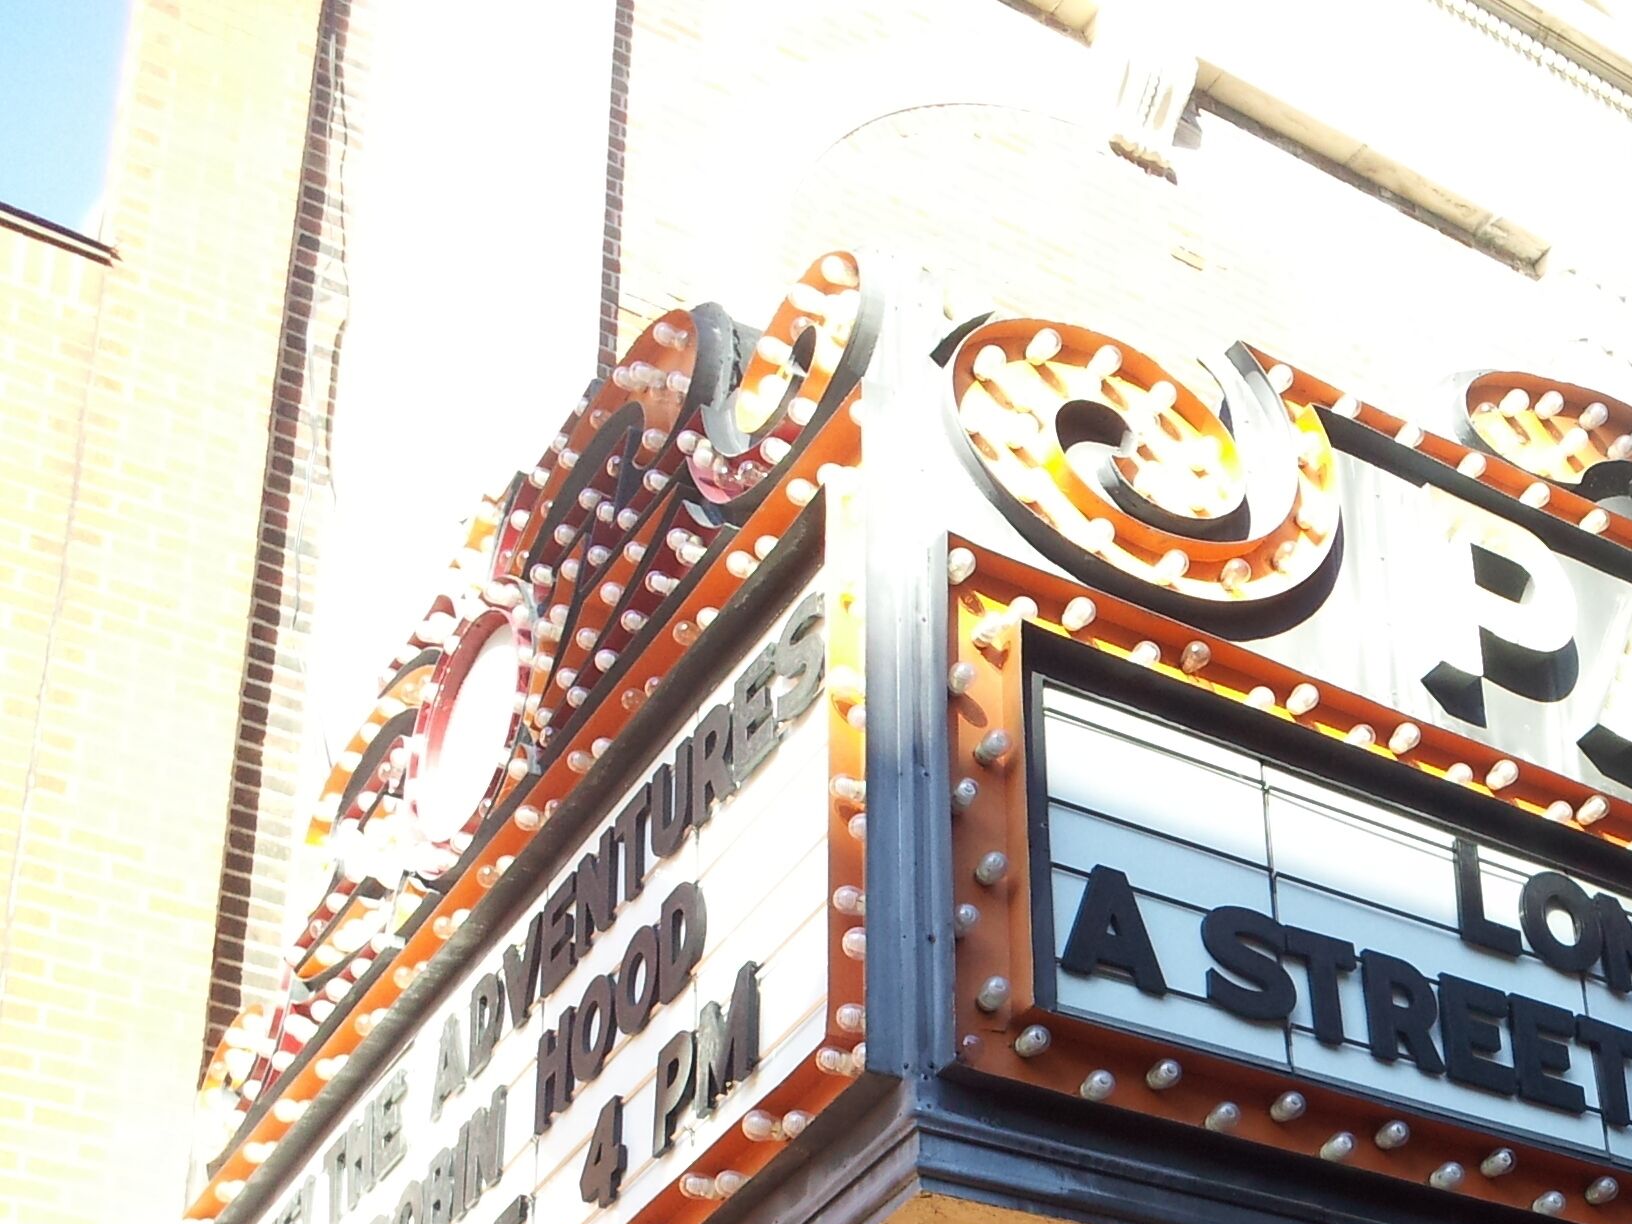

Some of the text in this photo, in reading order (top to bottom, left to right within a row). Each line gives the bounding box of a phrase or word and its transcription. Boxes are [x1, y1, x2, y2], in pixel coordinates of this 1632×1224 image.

[430, 591, 826, 1122] ADVENTURES
[1061, 863, 1167, 996] A
[534, 881, 707, 1136] HOOD
[580, 1094, 628, 1208] 4
[653, 960, 762, 1158] PM
